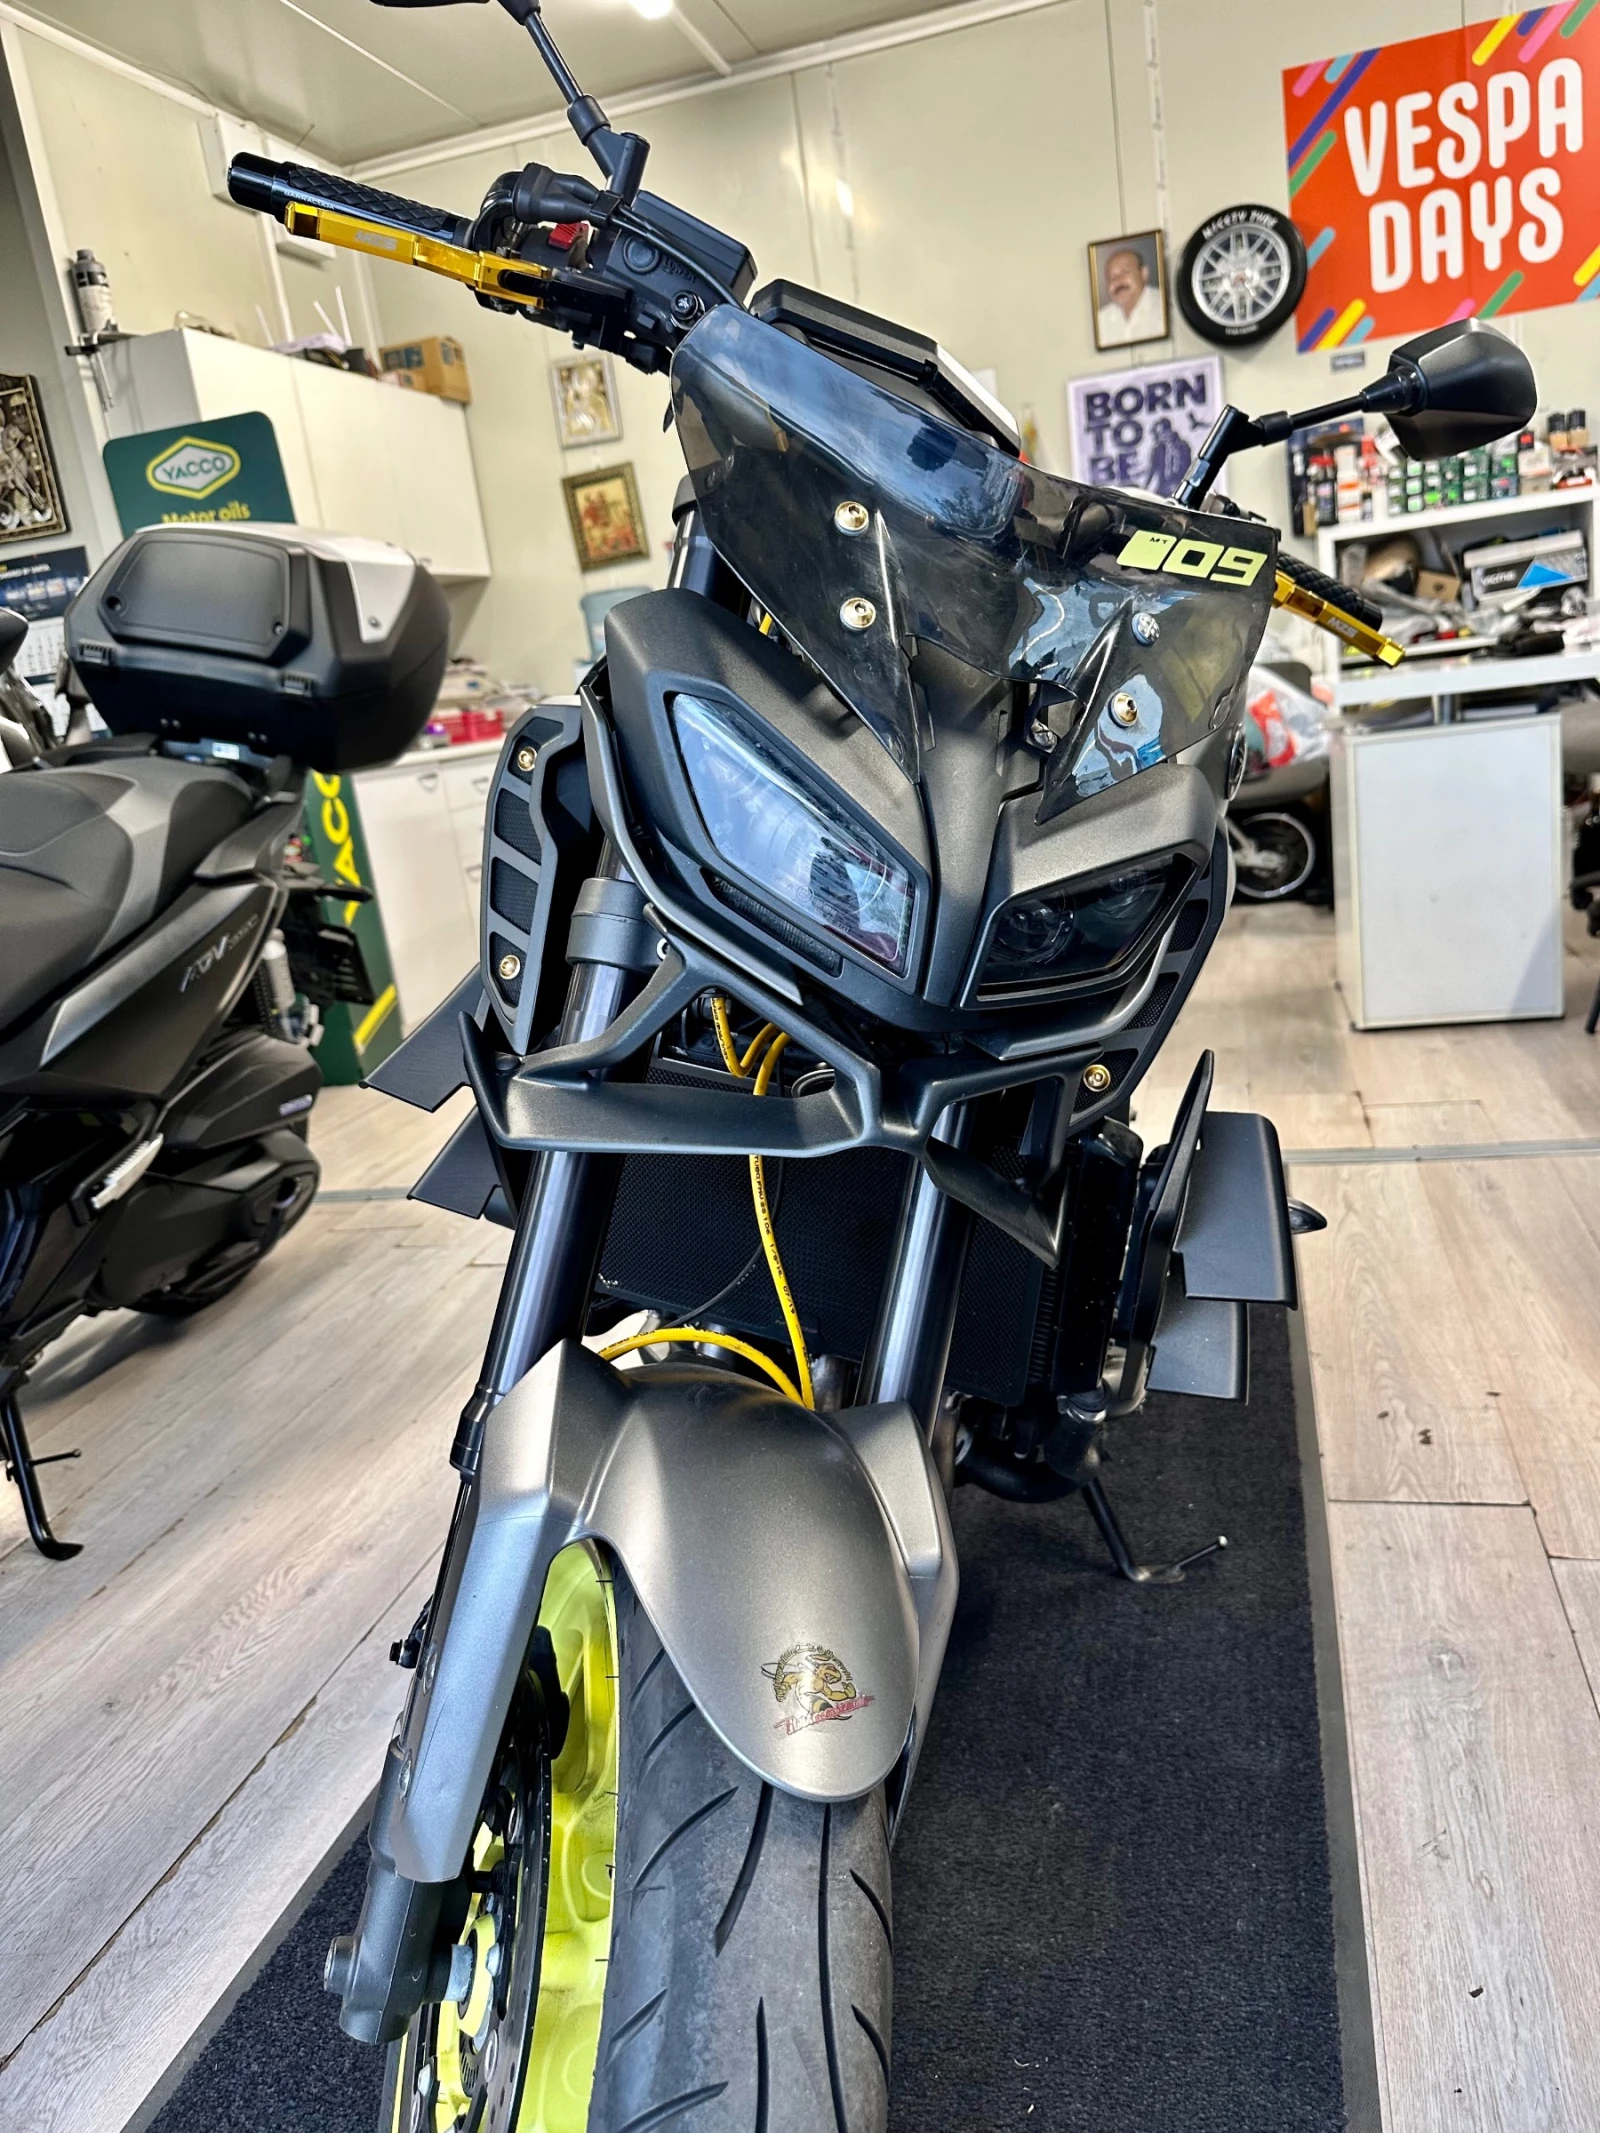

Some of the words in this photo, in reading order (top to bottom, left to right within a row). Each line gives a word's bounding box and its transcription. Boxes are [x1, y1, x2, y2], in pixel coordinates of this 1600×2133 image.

[1344, 57, 1583, 197] VESPA
[1368, 167, 1564, 294] DAYS
[1085, 374, 1207, 421] BORN
[1085, 420, 1143, 456] TO
[162, 456, 227, 481] YACCO
[1089, 451, 1143, 486] BE
[218, 500, 250, 520] oils
[1163, 539, 1268, 587] 09
